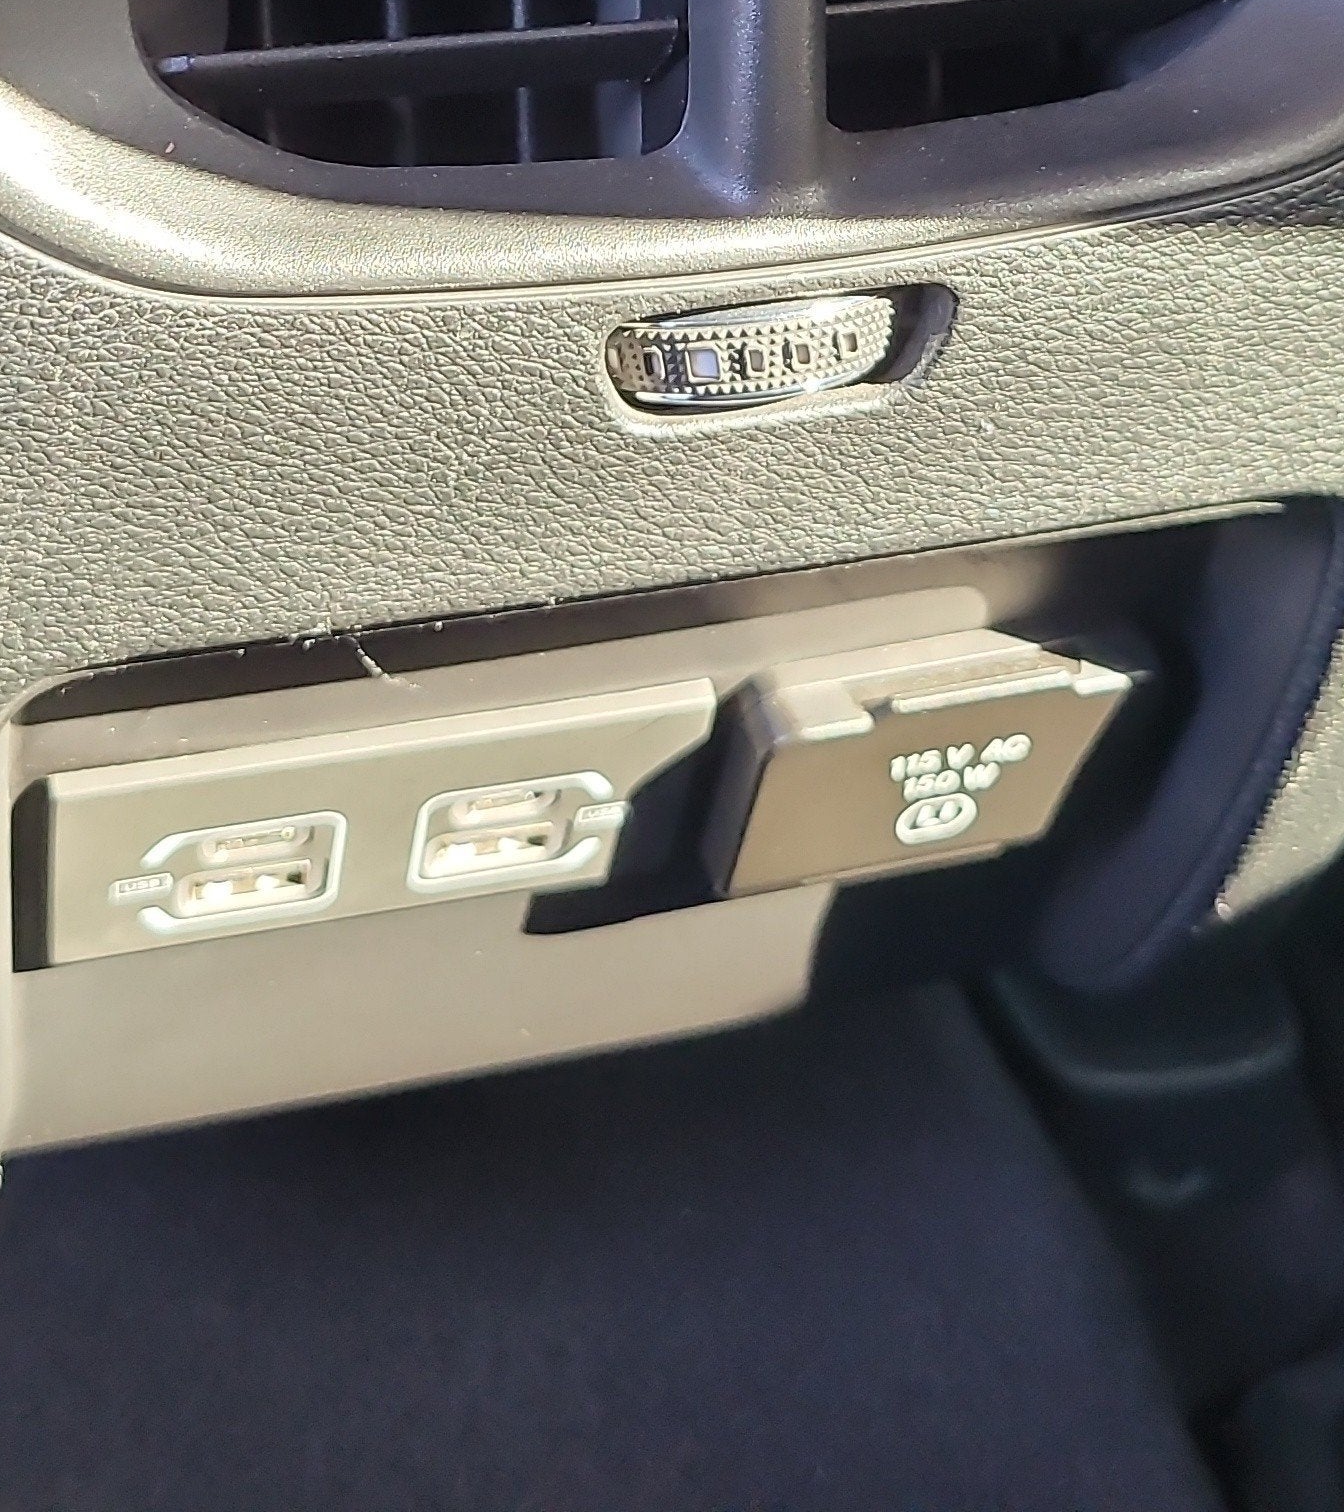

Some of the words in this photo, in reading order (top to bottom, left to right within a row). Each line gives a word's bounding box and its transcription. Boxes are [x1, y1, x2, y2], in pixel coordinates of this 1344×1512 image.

[890, 749, 942, 781] 115
[946, 743, 975, 770] V
[980, 734, 1032, 763] AC
[903, 769, 961, 802] 150
[963, 761, 1001, 791] W
[123, 877, 161, 892] USB
